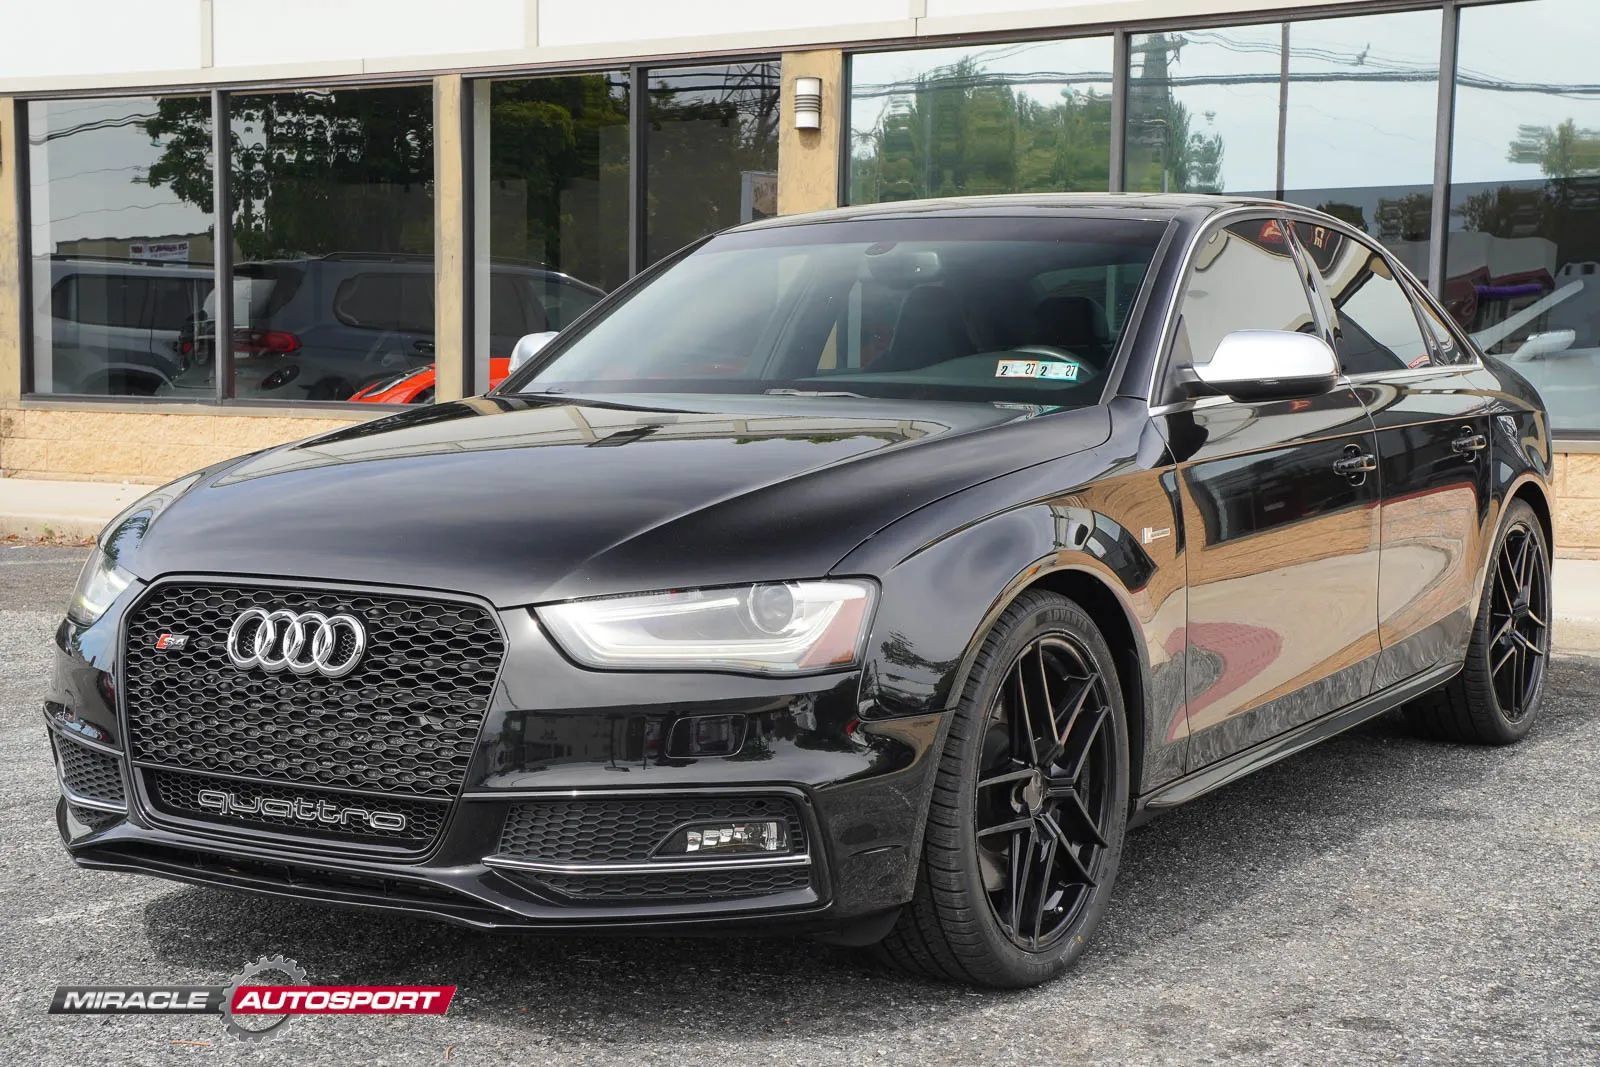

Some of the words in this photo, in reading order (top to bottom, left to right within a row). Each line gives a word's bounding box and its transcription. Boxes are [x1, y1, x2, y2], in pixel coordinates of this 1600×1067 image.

[1000, 365, 1008, 376] 2
[1025, 363, 1036, 375] 27
[1040, 365, 1048, 377] 2
[1065, 364, 1076, 377] 27
[161, 636, 186, 649] S4
[198, 789, 406, 832] quattro
